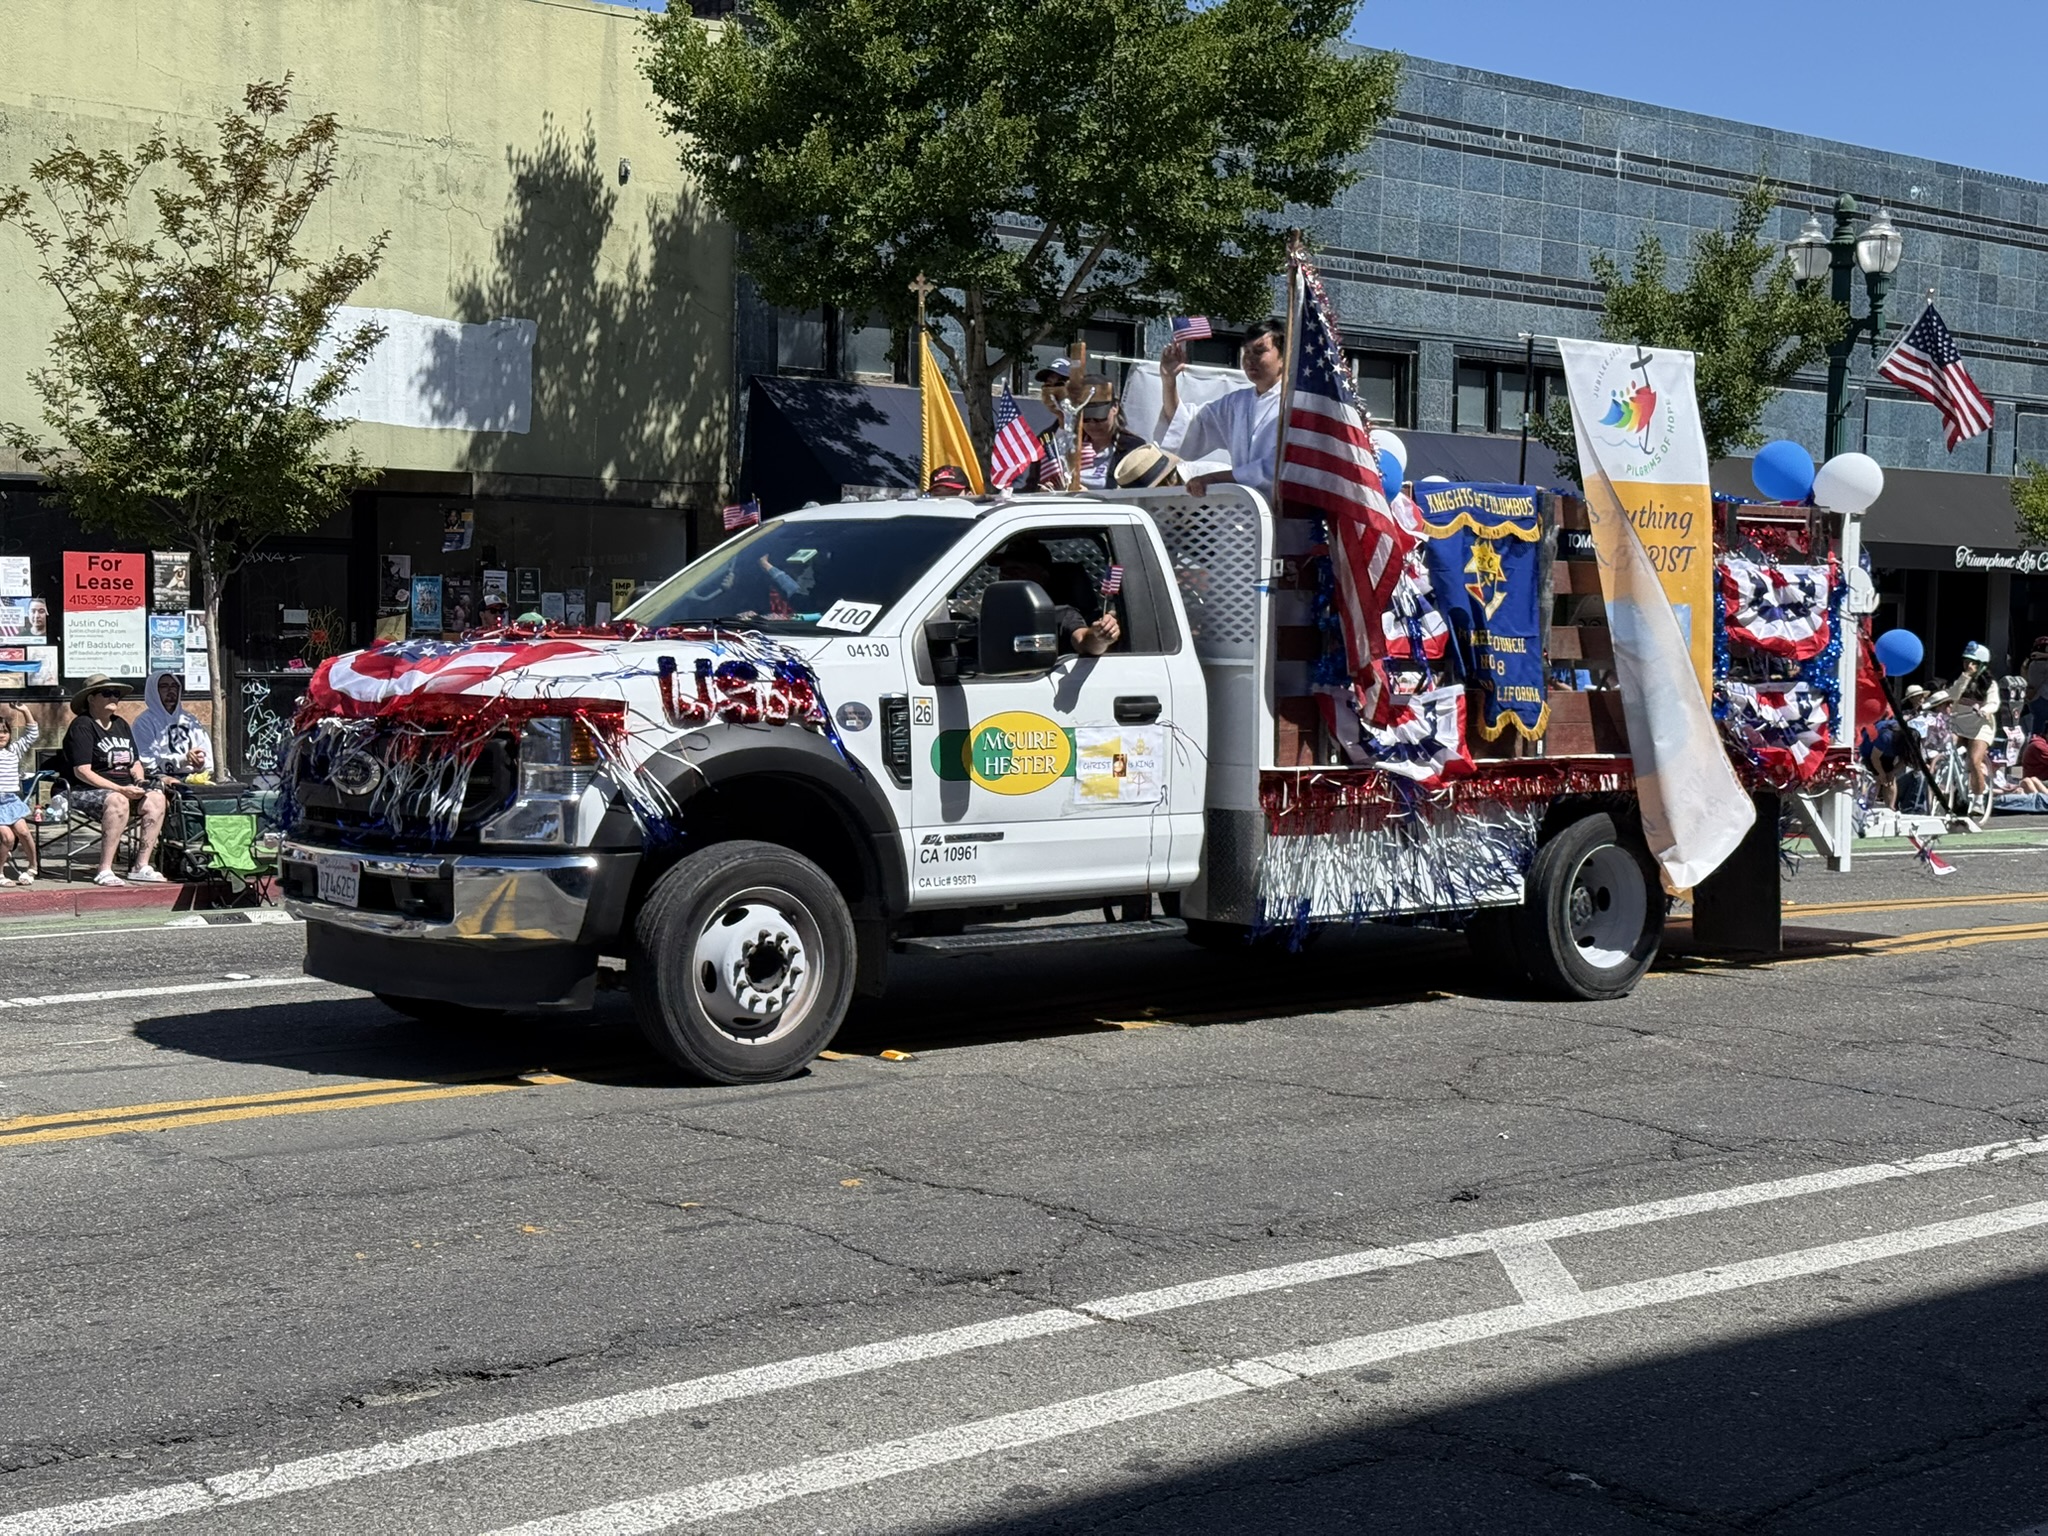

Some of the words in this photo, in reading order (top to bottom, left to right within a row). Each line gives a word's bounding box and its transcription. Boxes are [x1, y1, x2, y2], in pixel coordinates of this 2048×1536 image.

[1626, 453, 1662, 477] PILGRIMS
[1660, 436, 1672, 454] OF
[1666, 398, 1676, 434] HOPE
[1424, 487, 1474, 514] KNIGHTS
[1483, 493, 1535, 516] COLUMBUS
[1567, 533, 1595, 549] TOM
[88, 555, 123, 572] For
[1643, 545, 1697, 573] RIST
[1955, 545, 2016, 572] Triumphant
[2015, 549, 2037, 574] Life
[76, 573, 135, 591] Lease
[615, 582, 632, 590] IMP
[69, 594, 142, 606] 415.395.7262
[68, 619, 96, 628] Justin
[97, 619, 119, 628] Choi
[828, 606, 873, 626] 100
[68, 641, 85, 650] Jeff
[87, 641, 136, 650] Badstubner
[846, 643, 890, 658] 04130
[1493, 635, 1527, 654] OUNCIL
[915, 704, 932, 723] 26
[984, 755, 1059, 776] HESTER
[1082, 761, 1112, 771] CHRIST
[1134, 761, 1155, 770] KING
[920, 848, 940, 864] CA
[943, 845, 978, 862] 10961
[918, 877, 932, 888] CA
[933, 876, 952, 887] Lic#
[952, 874, 977, 886] 95879
